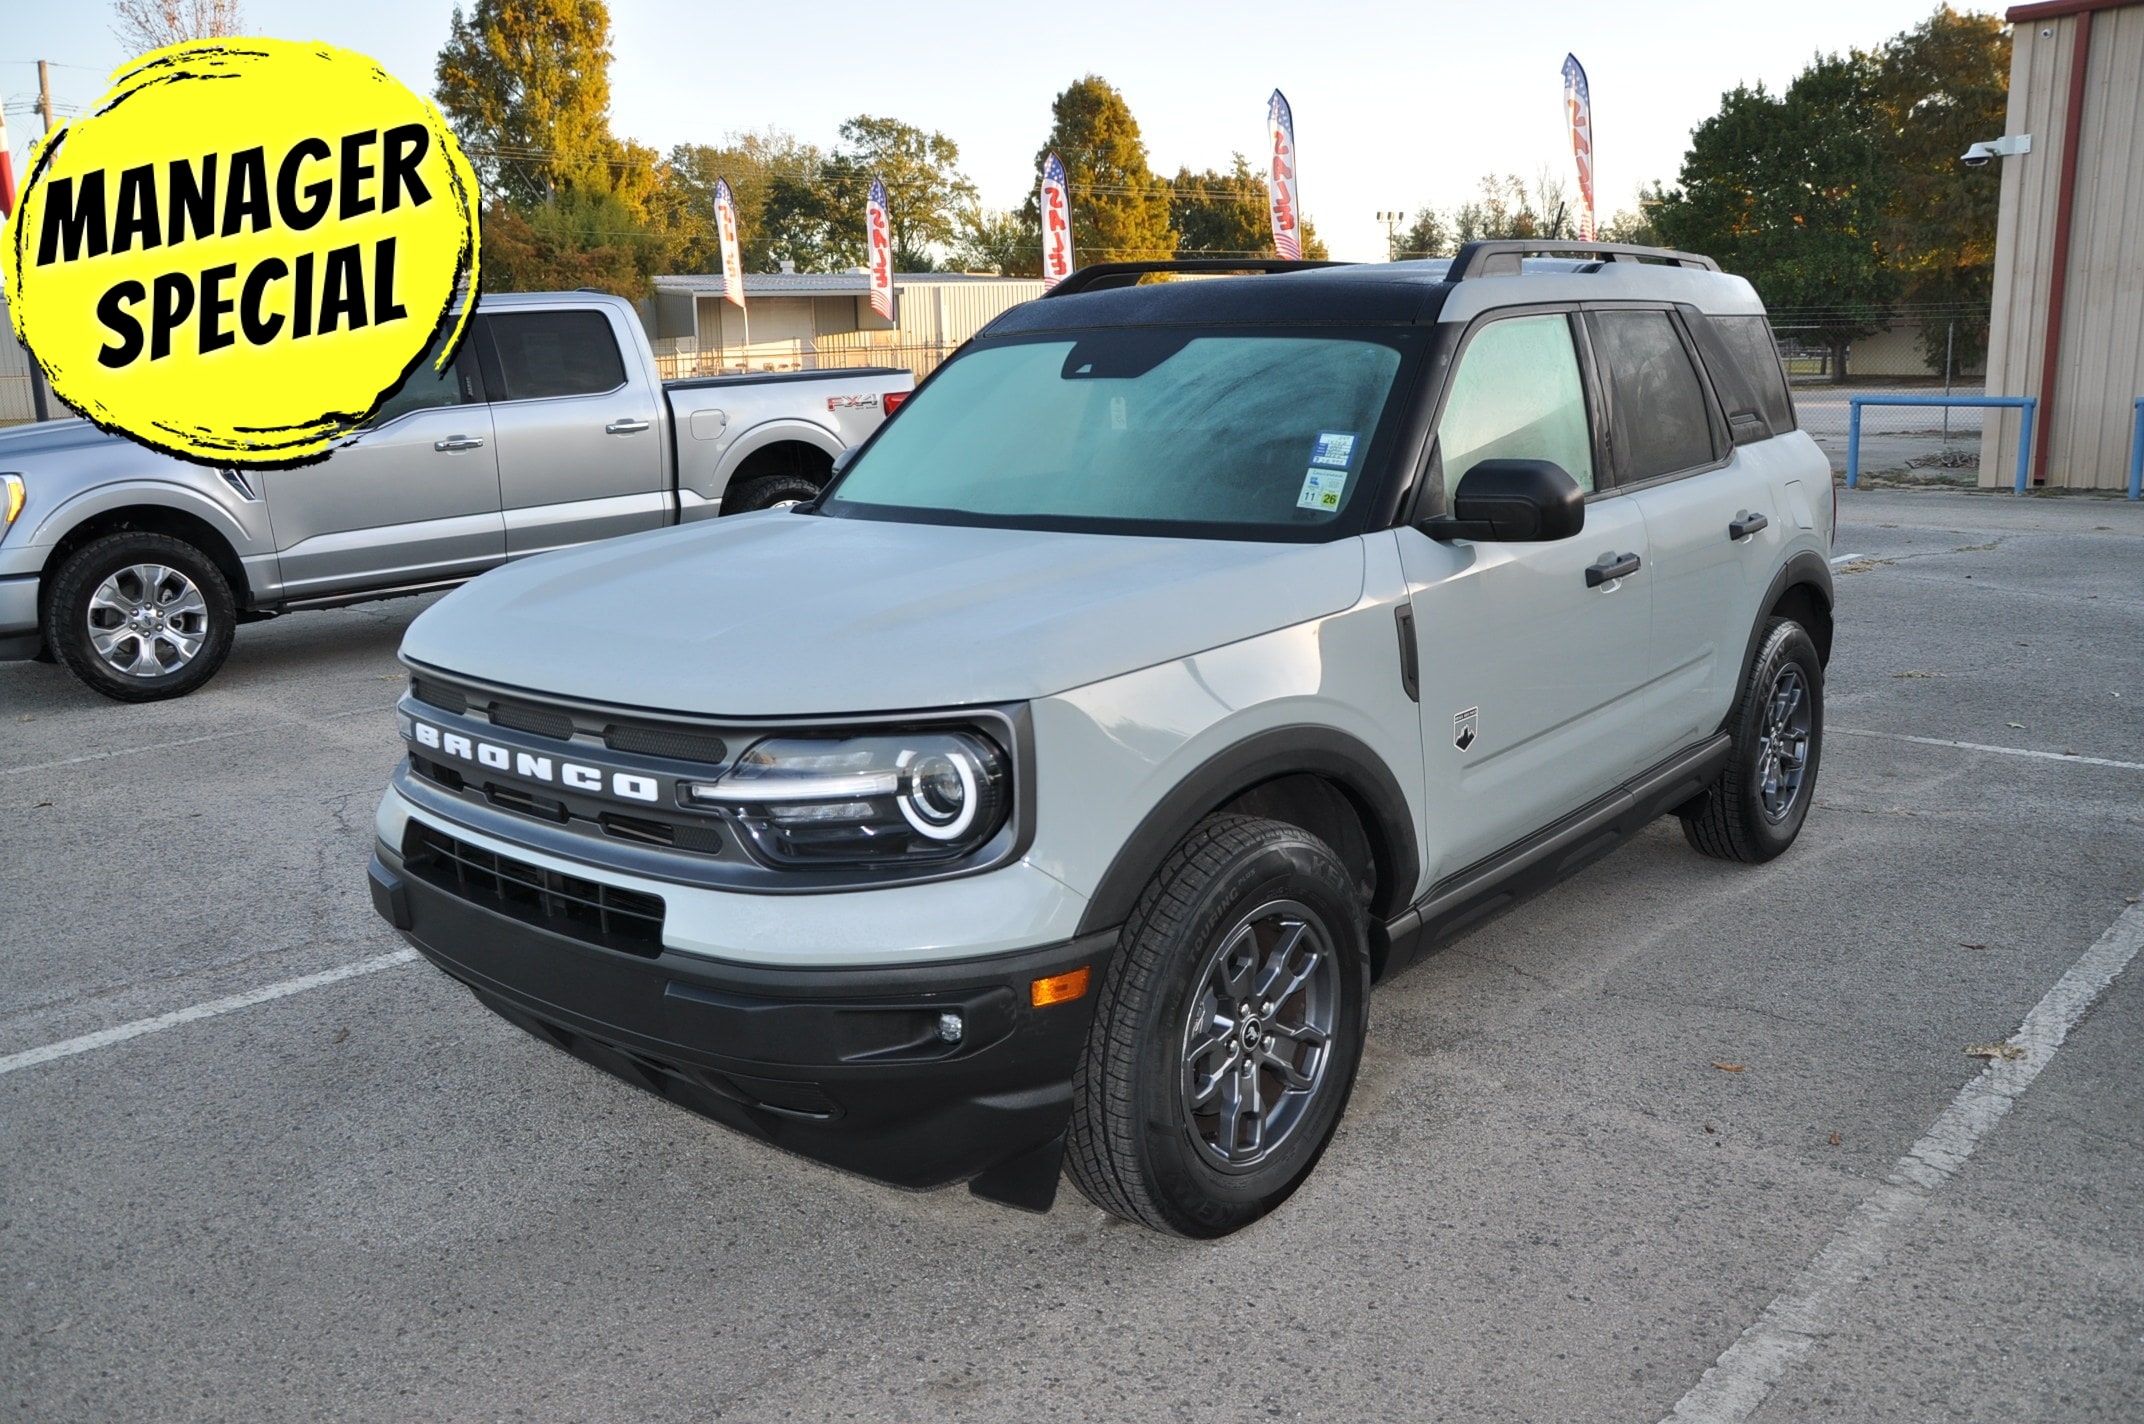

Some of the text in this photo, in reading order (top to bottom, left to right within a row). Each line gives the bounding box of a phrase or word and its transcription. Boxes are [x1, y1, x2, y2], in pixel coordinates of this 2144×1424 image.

[826, 394, 878, 411] FX4
[1304, 492, 1337, 504] 11 26
[415, 722, 658, 802] BRONCO
[1187, 867, 1257, 963] TOURING PLUS
